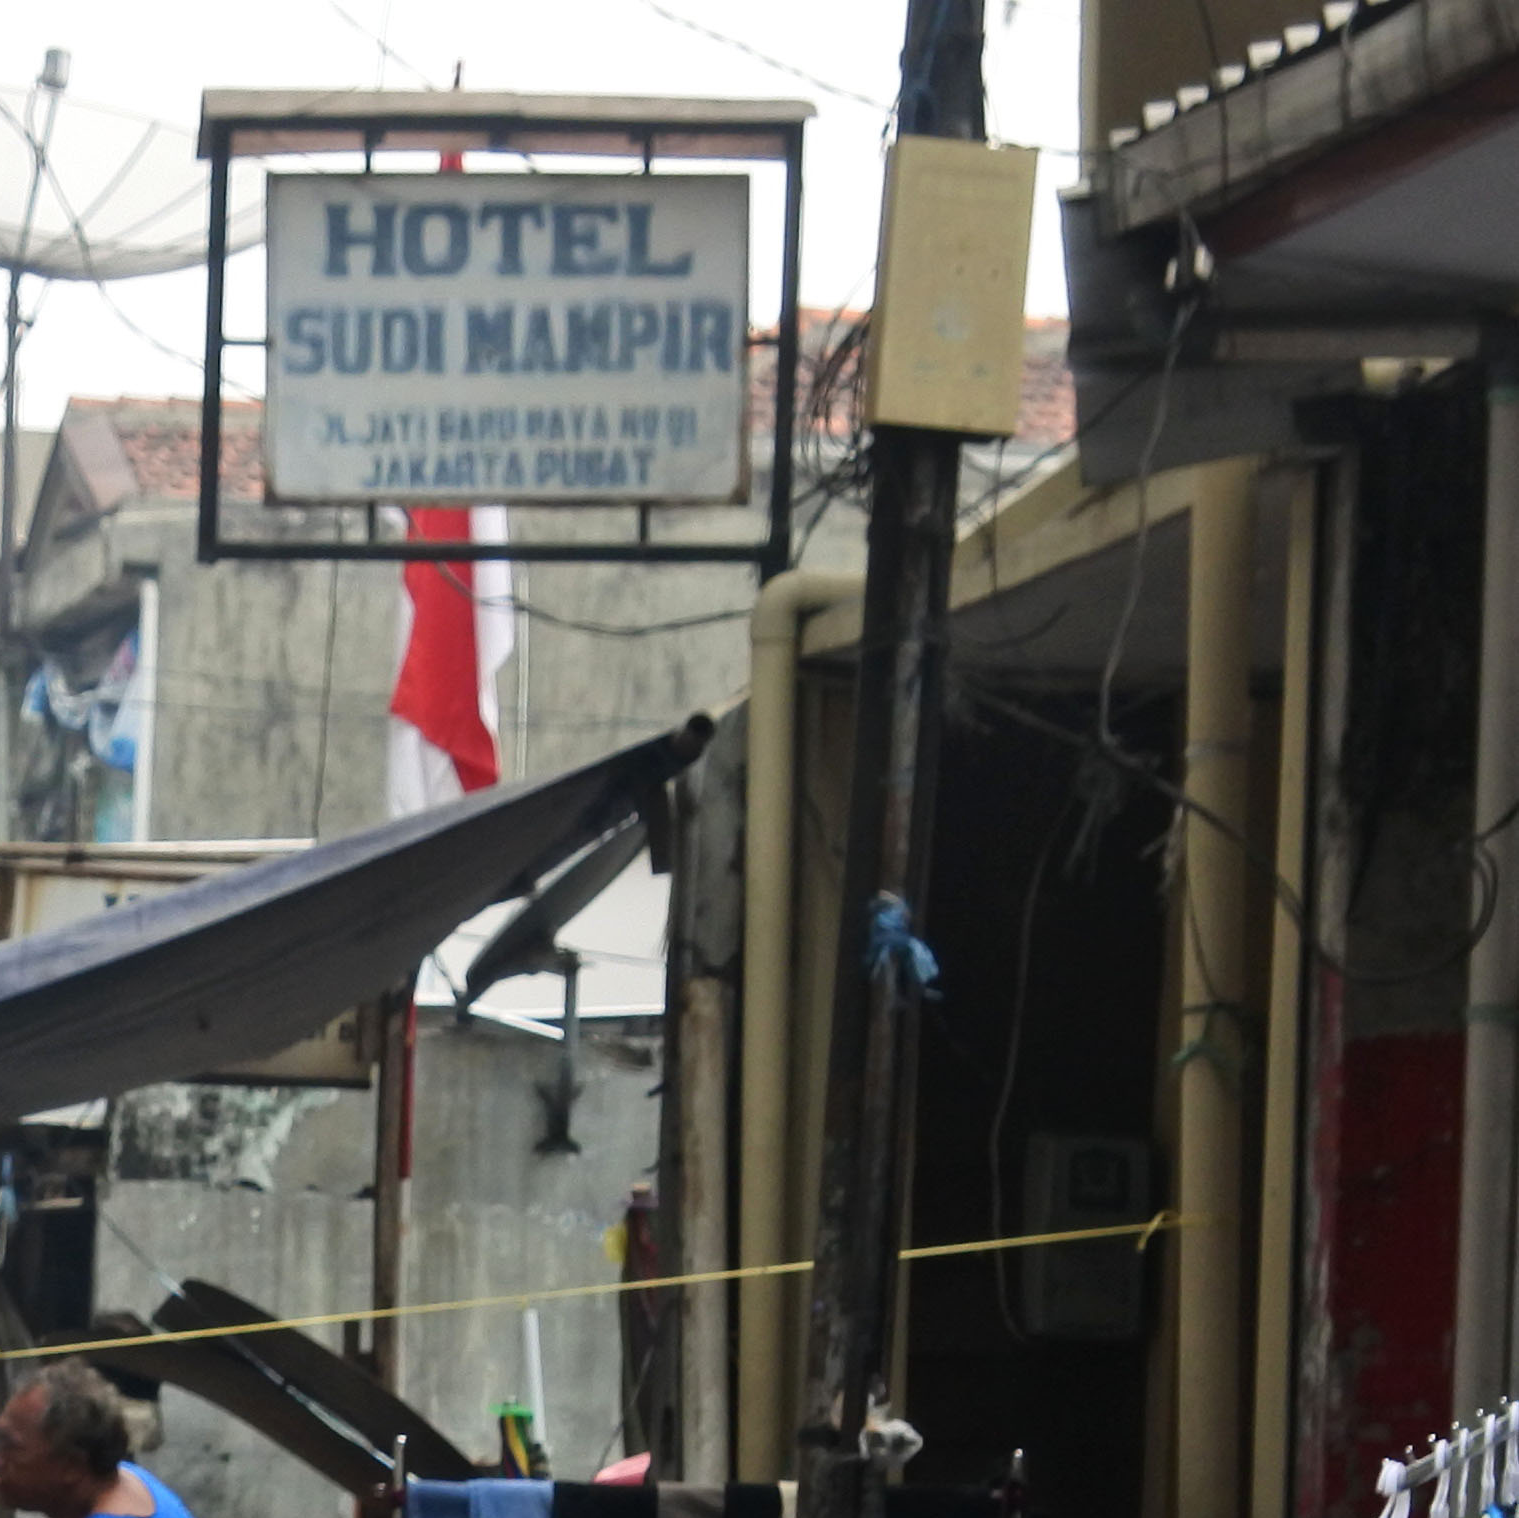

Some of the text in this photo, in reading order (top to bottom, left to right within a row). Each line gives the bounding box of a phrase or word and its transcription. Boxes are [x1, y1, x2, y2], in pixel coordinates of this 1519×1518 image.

[324, 203, 695, 278] HOTEL
[282, 299, 734, 377] SUDI MAMPIR
[363, 449, 524, 488] JAKARTA
